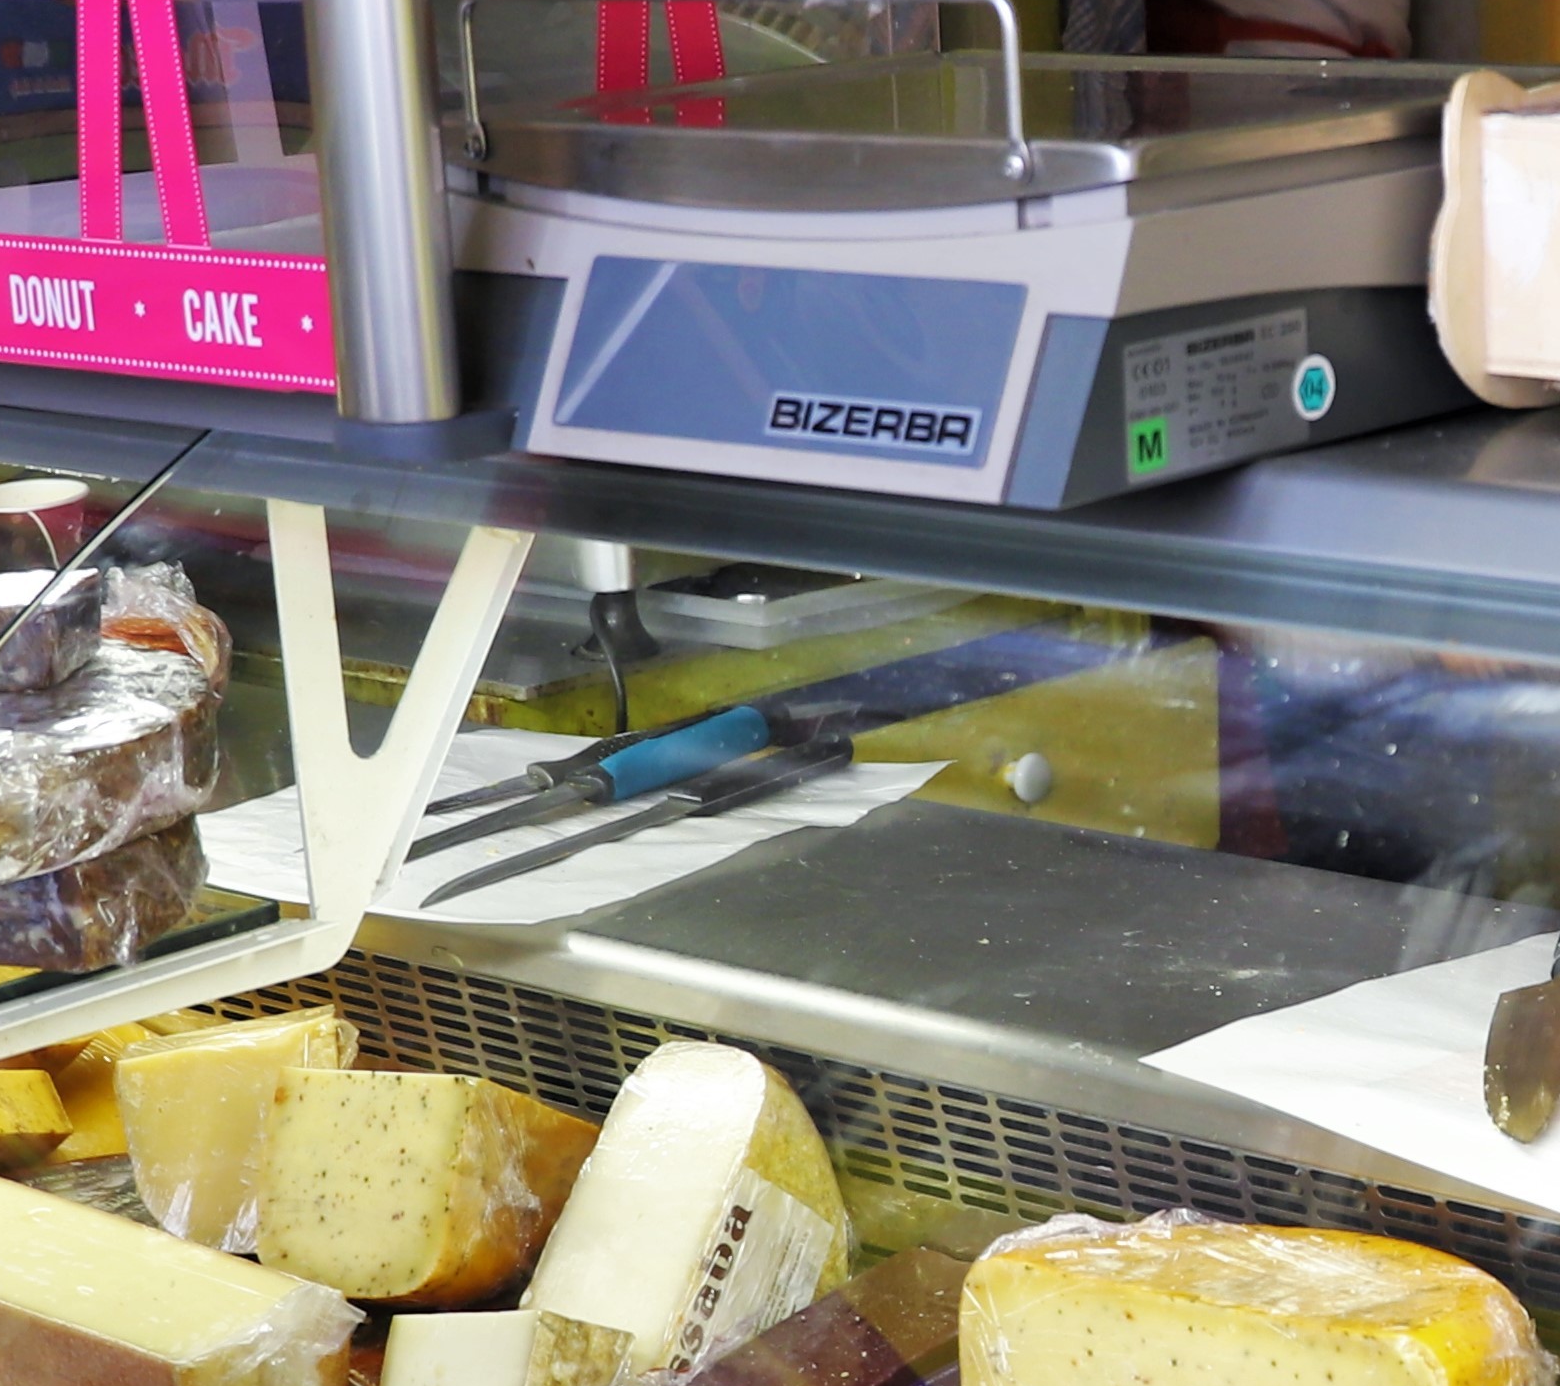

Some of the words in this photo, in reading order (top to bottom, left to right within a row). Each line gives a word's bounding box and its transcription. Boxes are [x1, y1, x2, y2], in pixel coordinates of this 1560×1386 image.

[9, 273, 96, 332] DONUT
[183, 287, 263, 348] CAKE
[769, 394, 972, 449] BIZERBA
[1138, 430, 1162, 463] M
